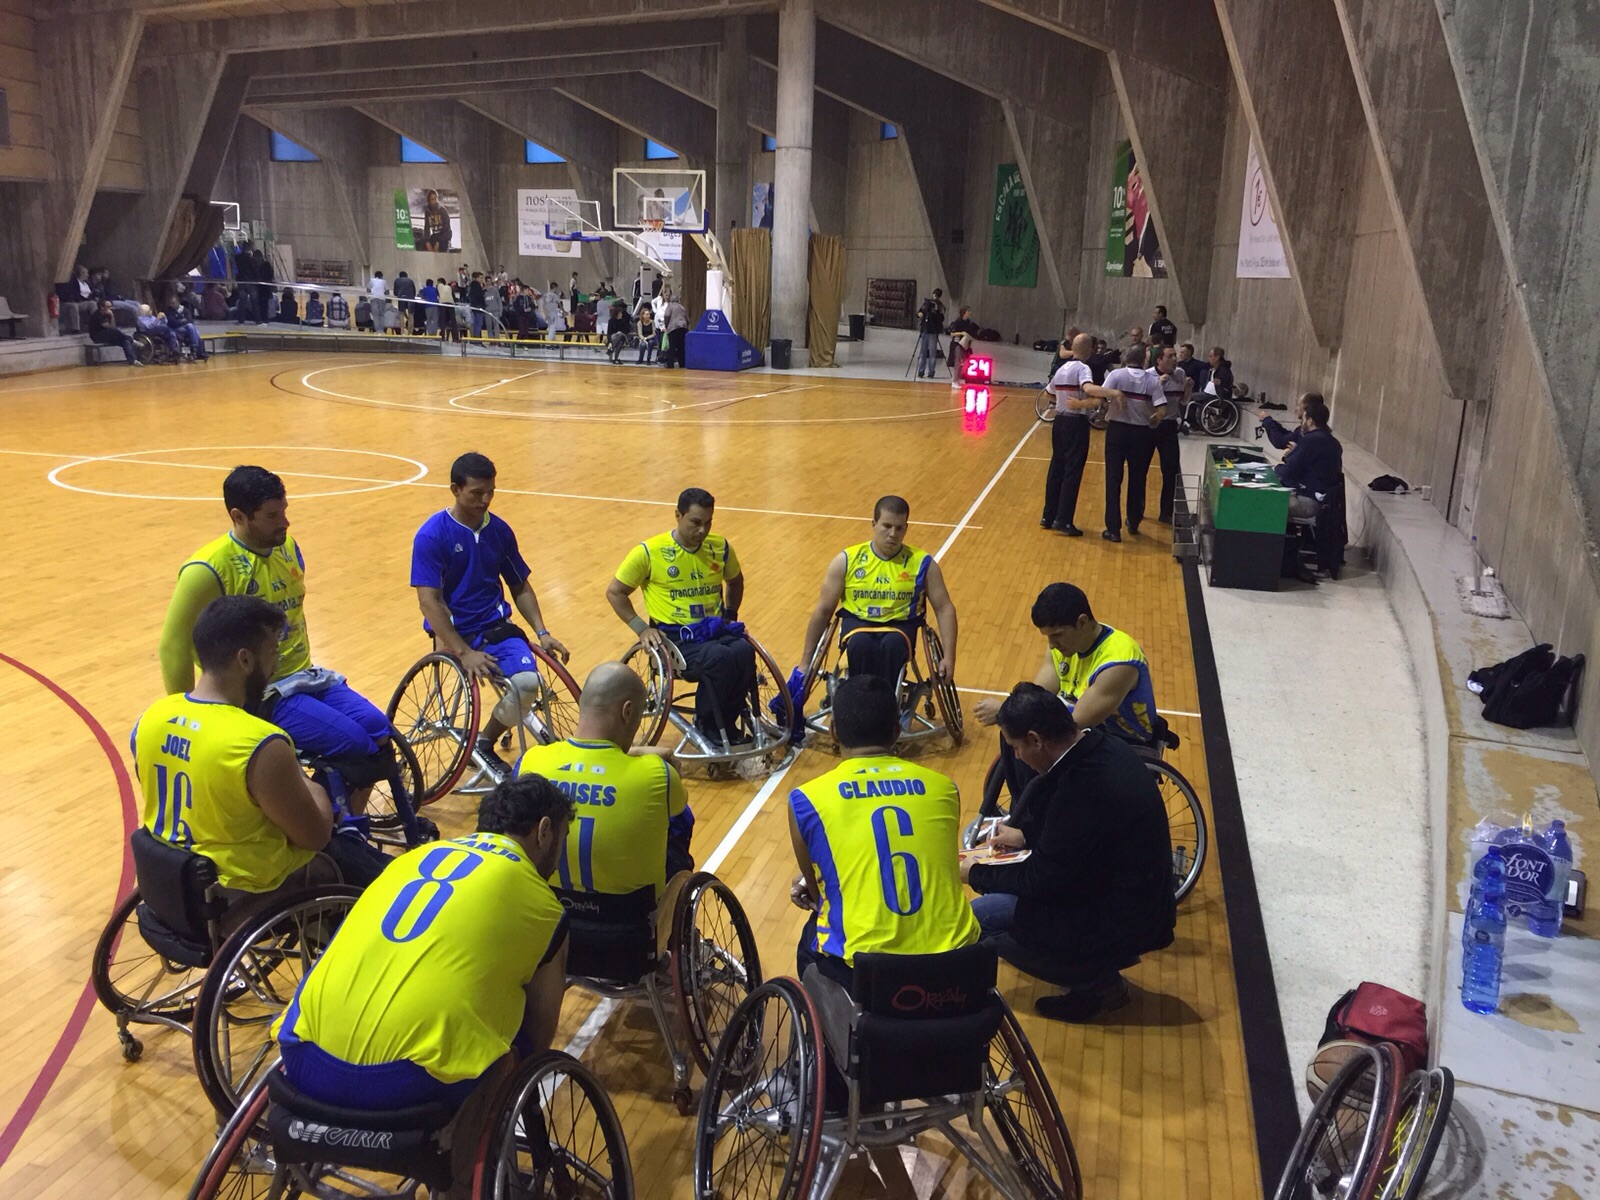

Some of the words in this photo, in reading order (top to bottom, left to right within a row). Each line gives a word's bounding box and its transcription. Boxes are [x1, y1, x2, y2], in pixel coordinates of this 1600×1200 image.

[967, 359, 990, 377] 24
[852, 588, 914, 602] grancanaria.com
[161, 733, 191, 763] JOEL
[838, 778, 927, 800] CLAUDIO
[871, 805, 924, 917] 6
[1507, 866, 1541, 887] DOR
[380, 846, 484, 944] 8
